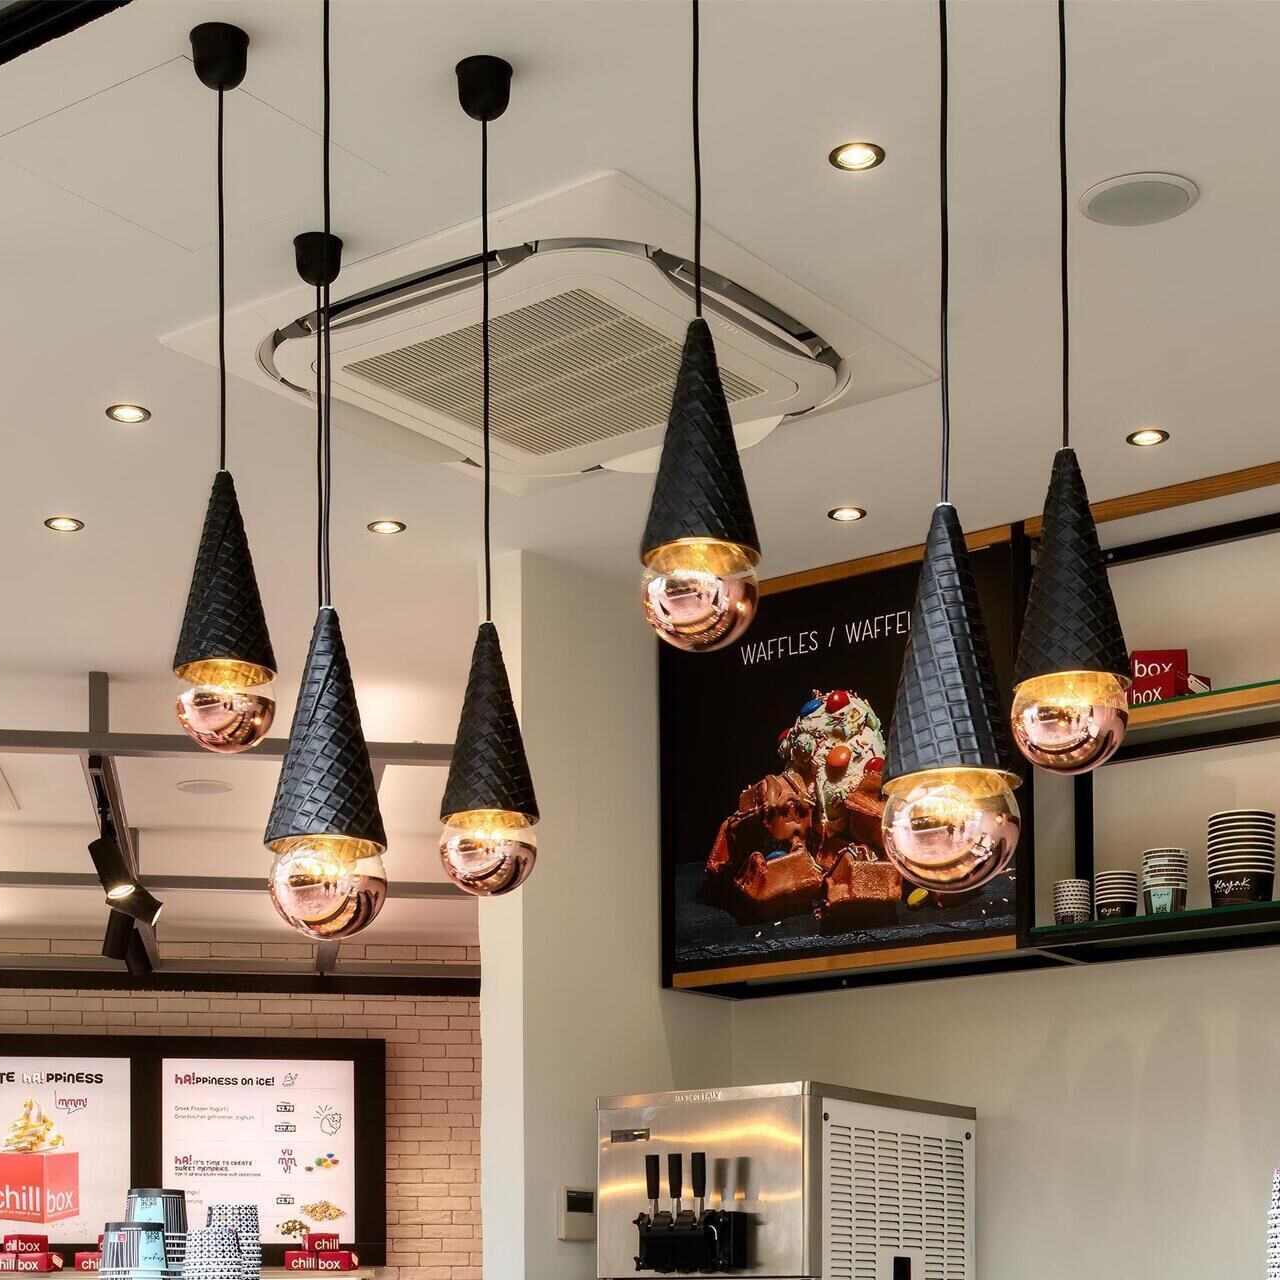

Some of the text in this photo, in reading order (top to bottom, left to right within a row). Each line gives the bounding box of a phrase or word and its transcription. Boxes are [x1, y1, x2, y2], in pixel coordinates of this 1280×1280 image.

[740, 630, 819, 665] WAFFLES
[828, 626, 835, 648] /
[1214, 877, 1252, 894] Kayak
[46, 1188, 74, 1214] box
[18, 1240, 41, 1252] box
[314, 1238, 340, 1250] chill
[17, 1258, 39, 1271] box
[291, 1257, 341, 1270] chill box
